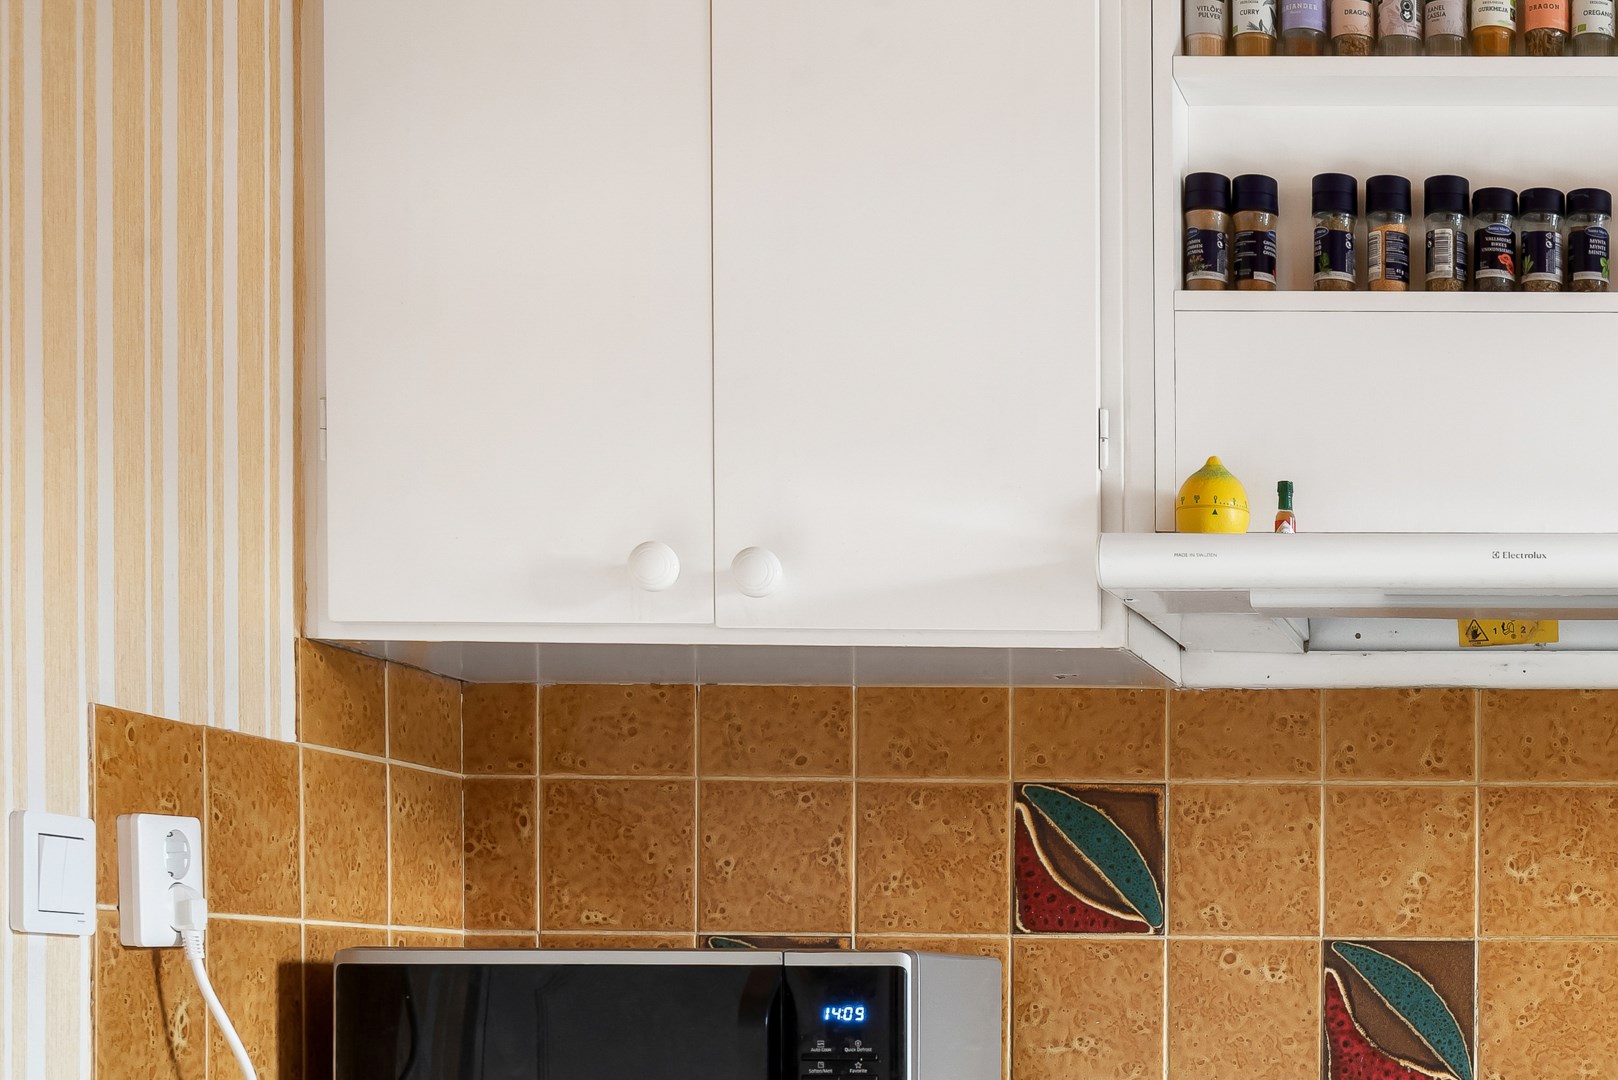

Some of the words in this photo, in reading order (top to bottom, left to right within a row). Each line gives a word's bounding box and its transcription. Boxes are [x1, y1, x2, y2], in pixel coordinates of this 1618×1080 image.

[1196, 5, 1222, 14] VITLÖKS
[1529, 3, 1560, 11] DRAGON
[1198, 12, 1221, 20] PULVER
[1344, 9, 1372, 18] DRAGON
[1427, 12, 1446, 20] CASSIA
[1583, 10, 1613, 19] OREGANO
[1502, 551, 1547, 559] Electrolux
[824, 1007, 864, 1020] 14:09
